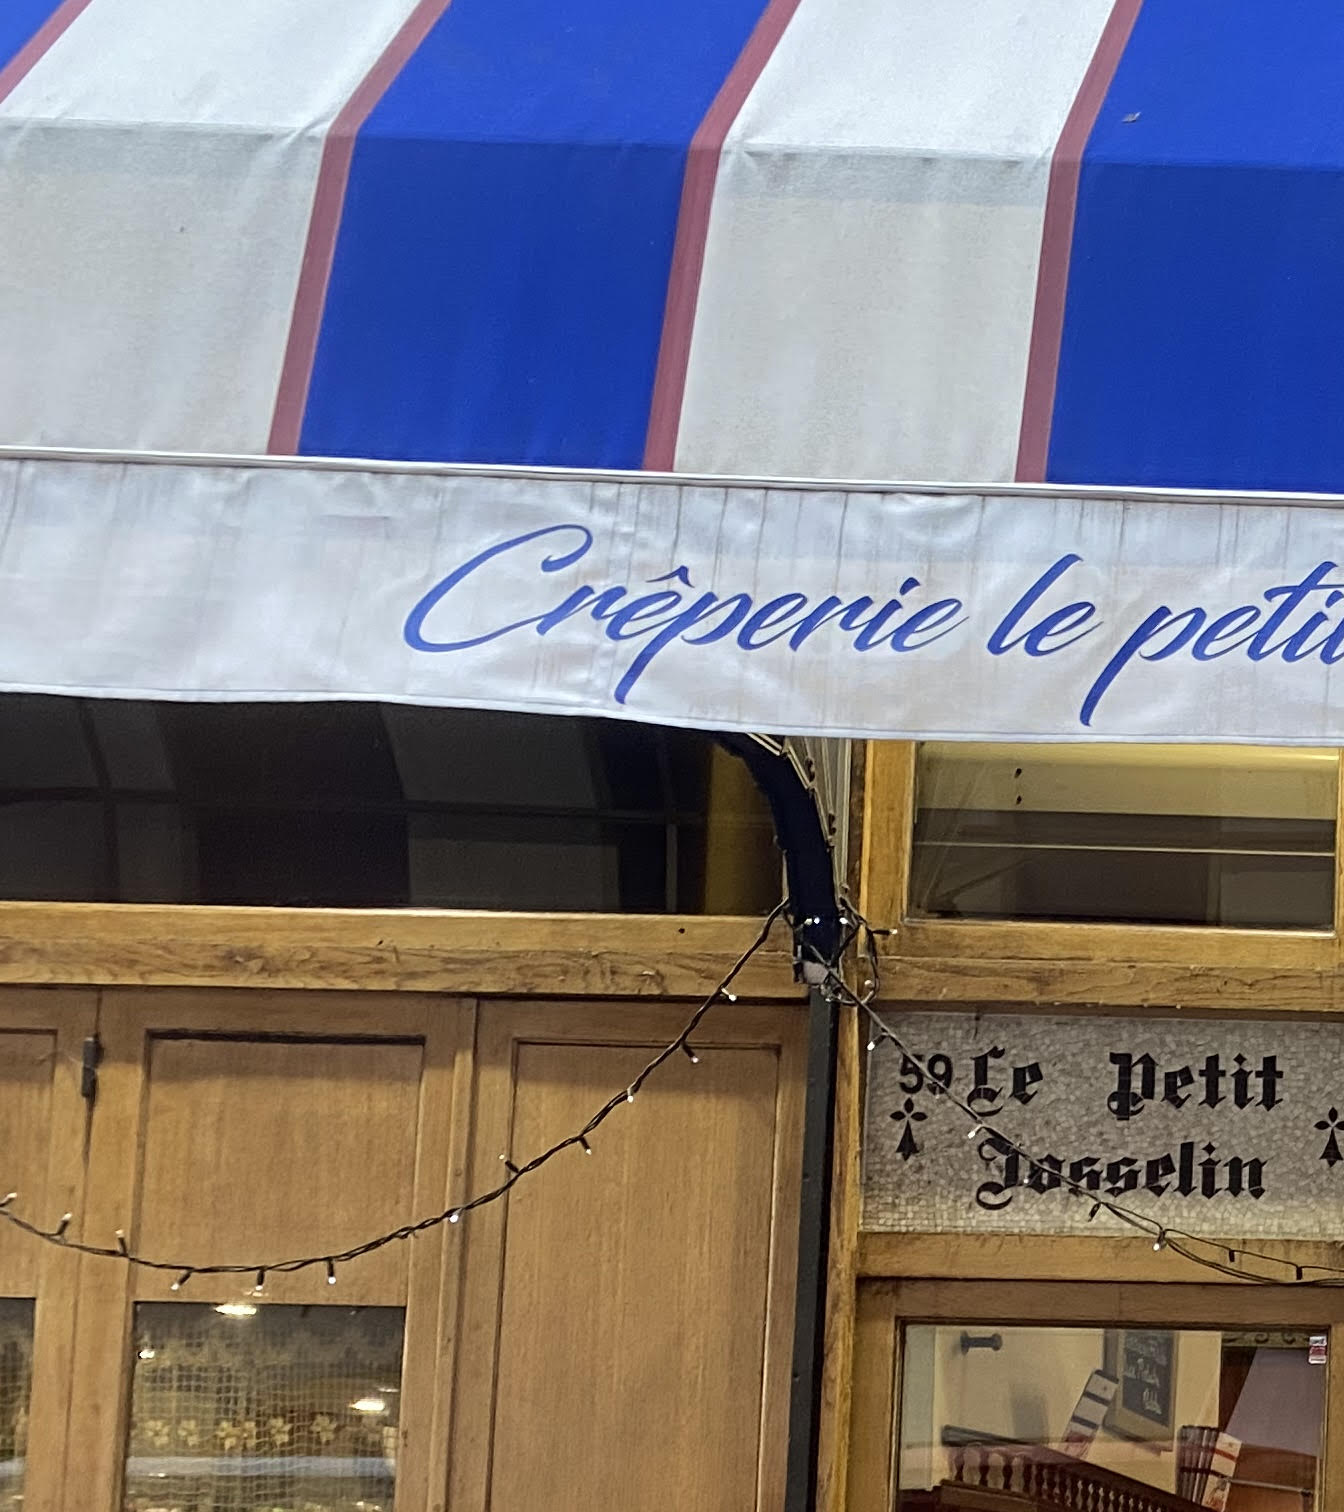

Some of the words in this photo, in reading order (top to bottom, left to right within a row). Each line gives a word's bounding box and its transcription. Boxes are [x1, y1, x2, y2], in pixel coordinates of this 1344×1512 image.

[404, 523, 962, 704] Crêperie
[985, 556, 1101, 659] le
[899, 1053, 953, 1096] 59
[966, 1045, 1044, 1117] Le
[1107, 1051, 1284, 1121] Petit
[974, 1137, 1271, 1211] Josselin
